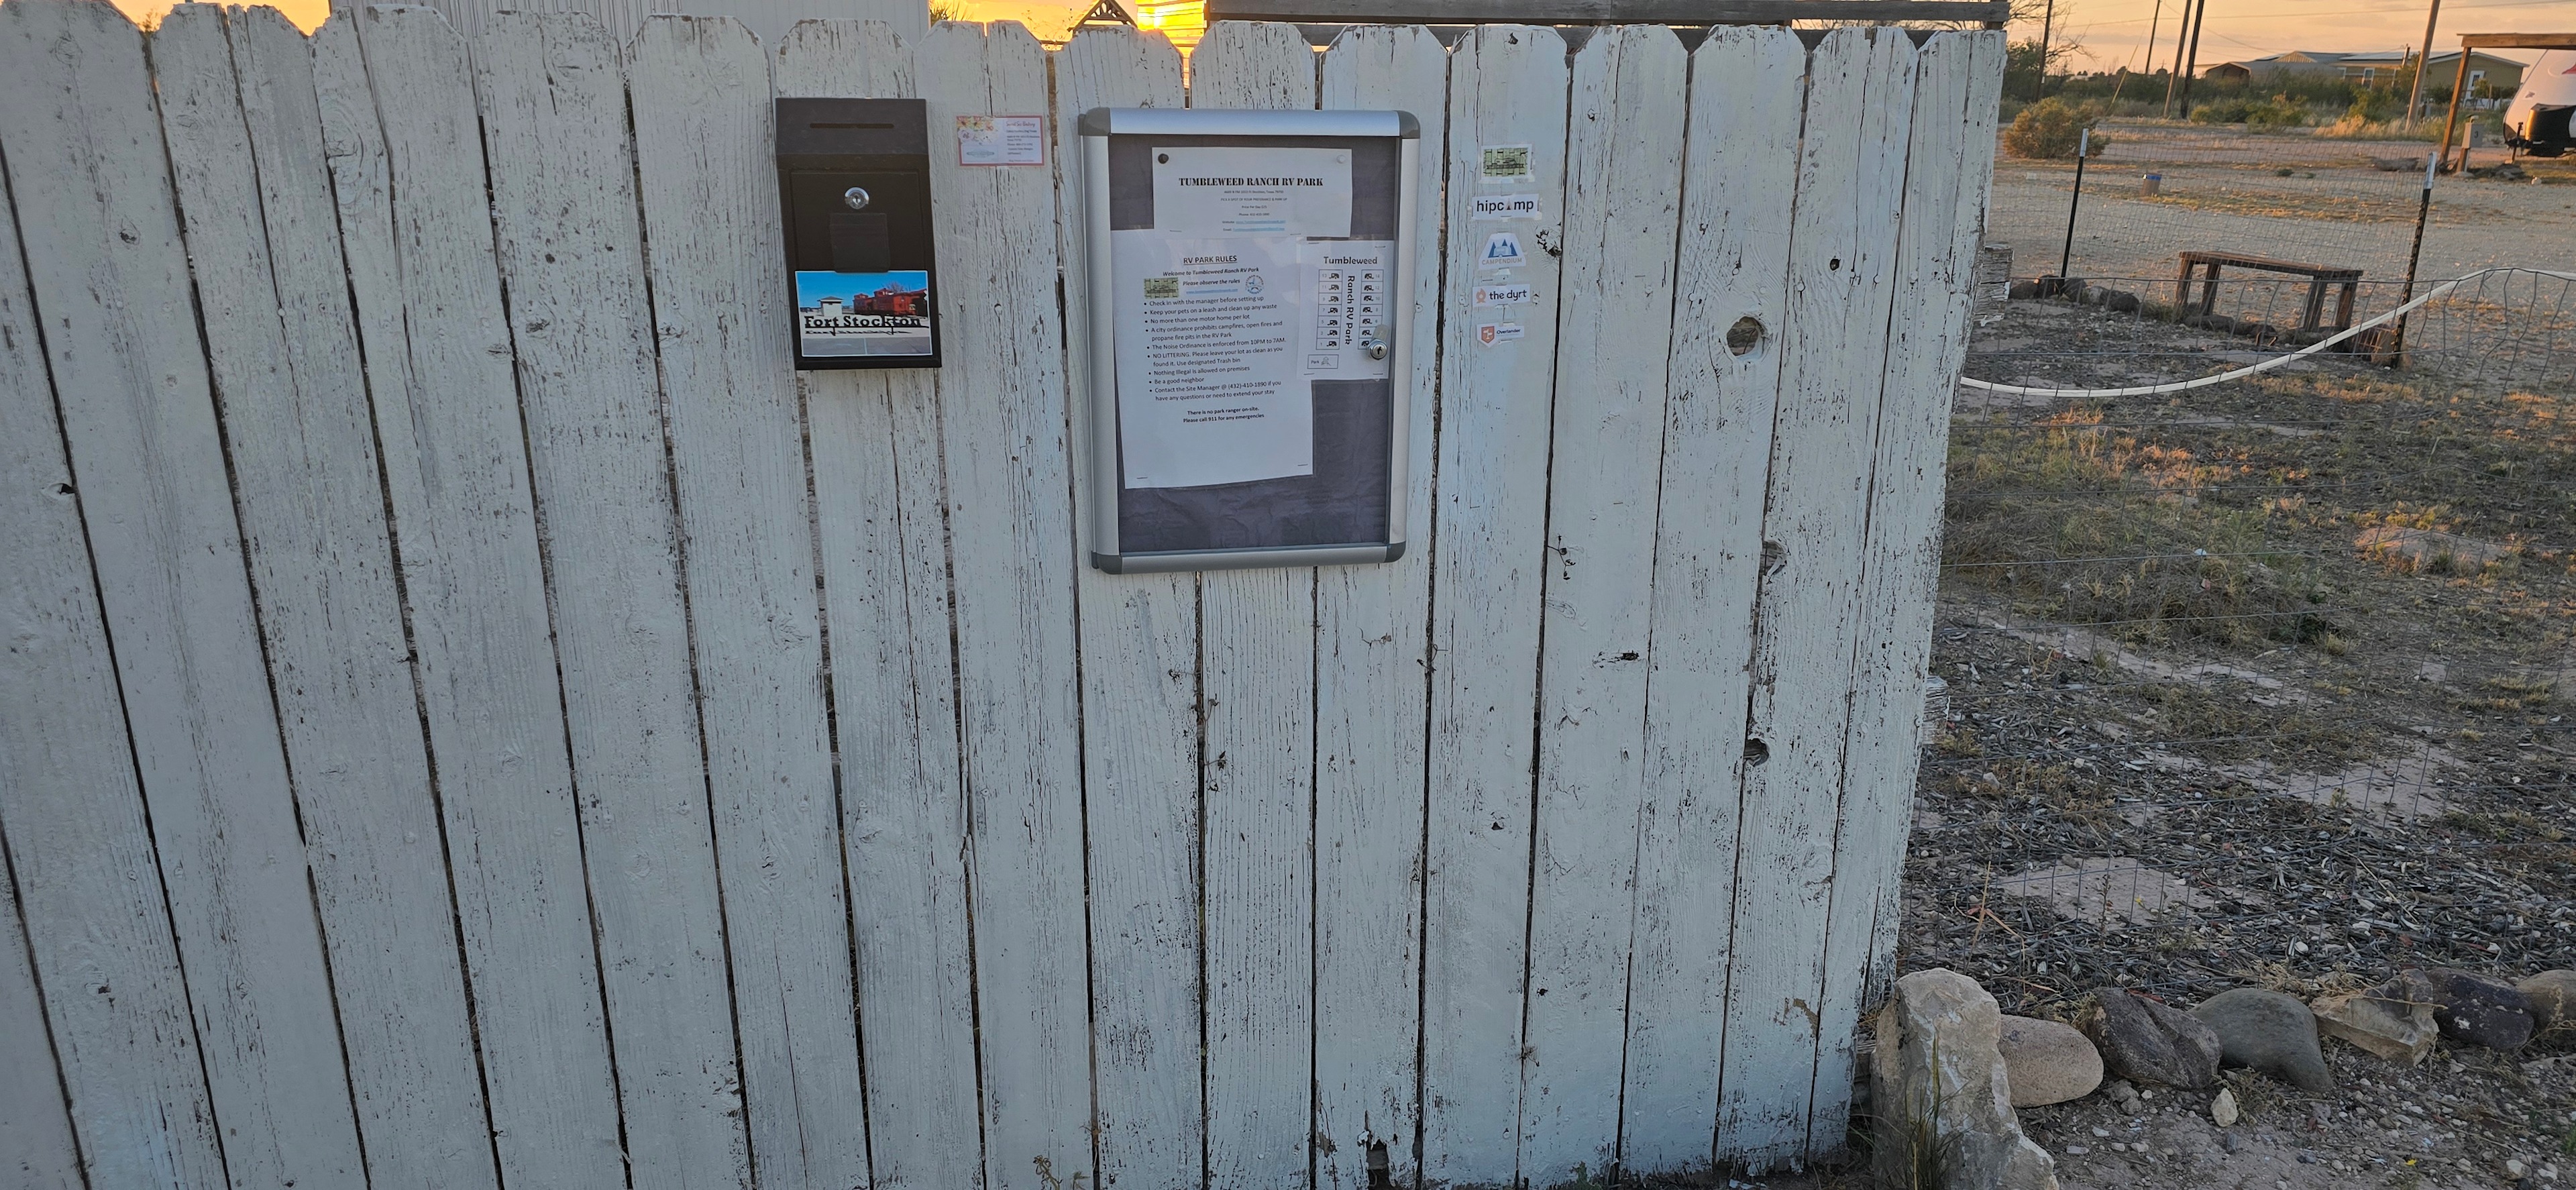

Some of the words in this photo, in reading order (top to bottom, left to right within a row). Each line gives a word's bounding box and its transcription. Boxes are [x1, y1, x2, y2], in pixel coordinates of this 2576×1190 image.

[1489, 291, 1504, 299] the
[1507, 290, 1527, 301] dyrt
[1346, 307, 1354, 320] RV
[804, 316, 839, 327] Fort
[843, 316, 922, 327] Stockton
[1228, 382, 1267, 390] (432)-410-1890
